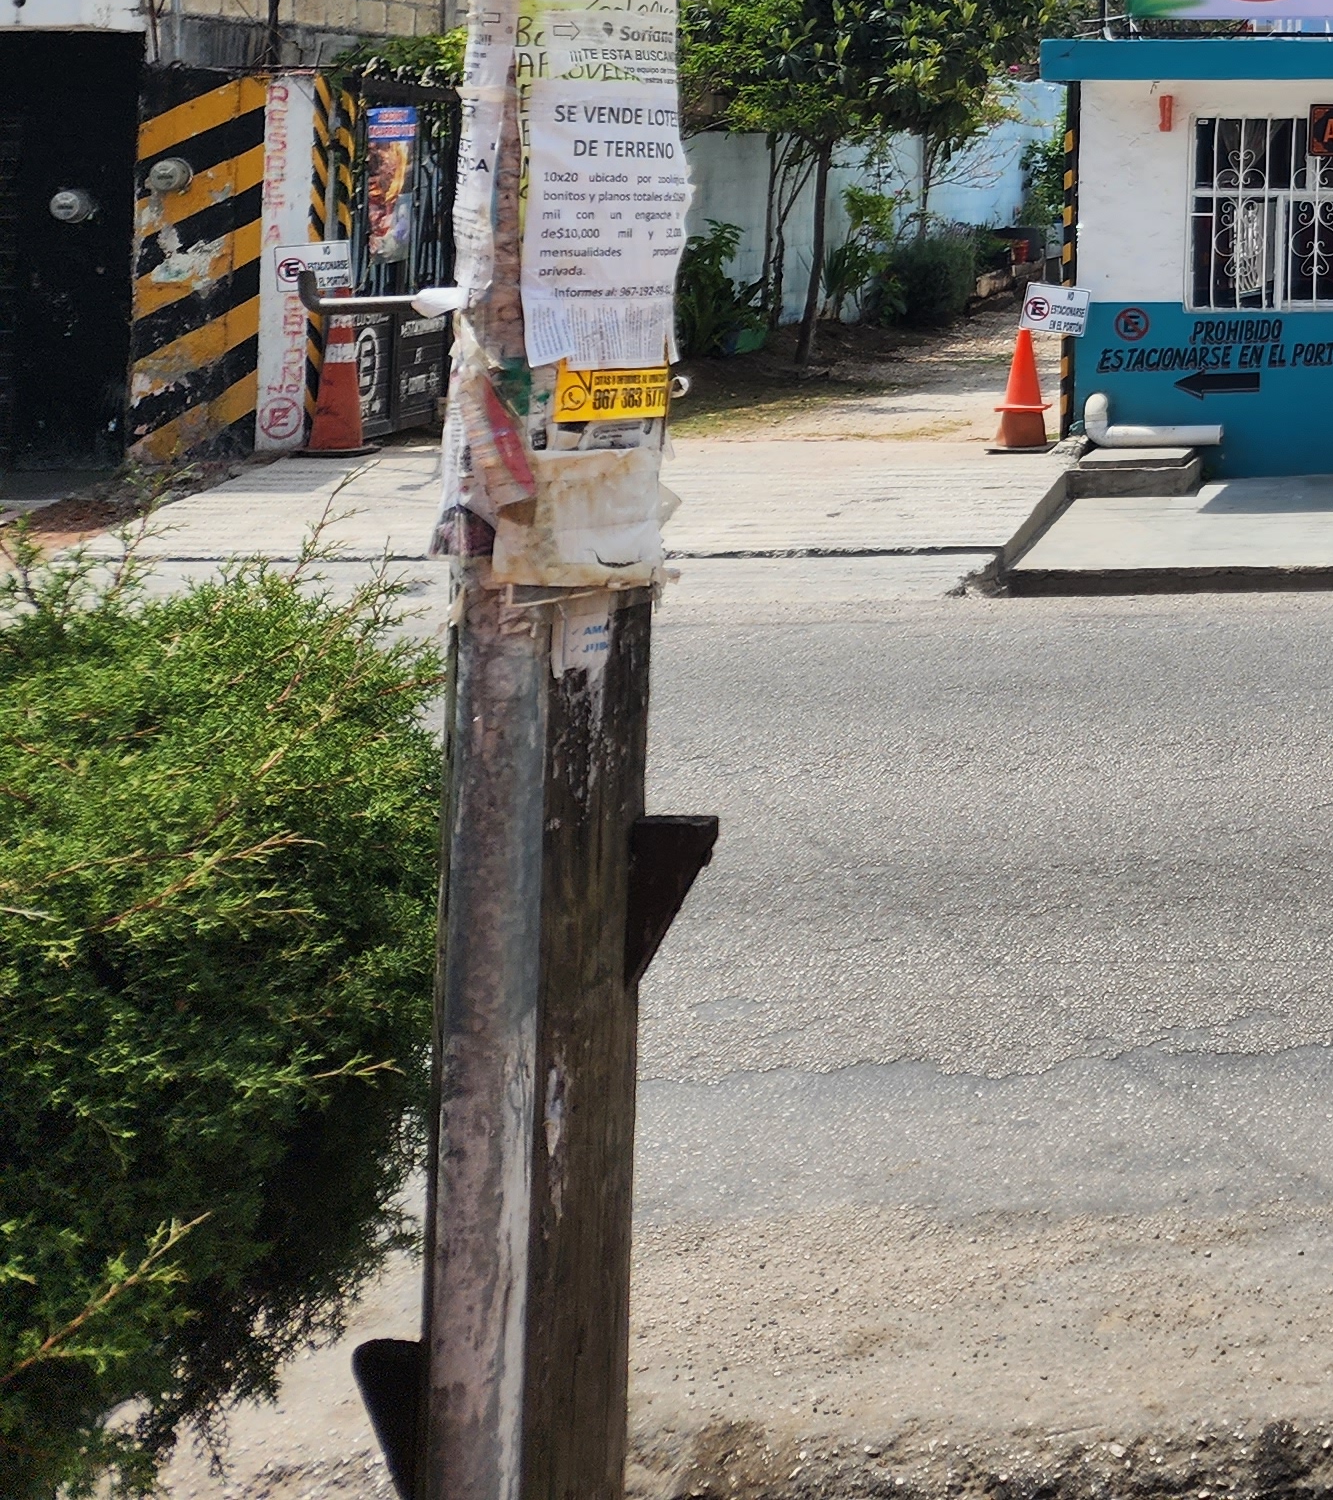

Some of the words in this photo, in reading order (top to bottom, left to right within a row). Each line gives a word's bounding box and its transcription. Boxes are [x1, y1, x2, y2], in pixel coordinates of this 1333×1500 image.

[602, 49, 632, 60] ESTA
[554, 105, 577, 122] SE
[584, 106, 643, 125] VENDE
[573, 140, 598, 156] DE
[604, 141, 674, 159] TERRENO
[543, 172, 579, 183] 10x20
[589, 173, 628, 183] ubicado
[637, 175, 652, 185] por
[543, 190, 586, 201] bonitos
[589, 192, 595, 204] y
[598, 191, 630, 204] planos
[633, 192, 663, 202] totales
[542, 209, 560, 220] mil
[576, 211, 594, 220] con
[610, 212, 622, 220] un
[618, 228, 632, 238] mil
[540, 247, 622, 258] mensualidades
[538, 266, 586, 277] privada.
[554, 286, 603, 298] Informes
[1190, 319, 1283, 344] PROHIBIDO
[1097, 345, 1231, 373] ESTACIONARSE
[1237, 345, 1263, 368] EN
[1268, 345, 1286, 368] EL
